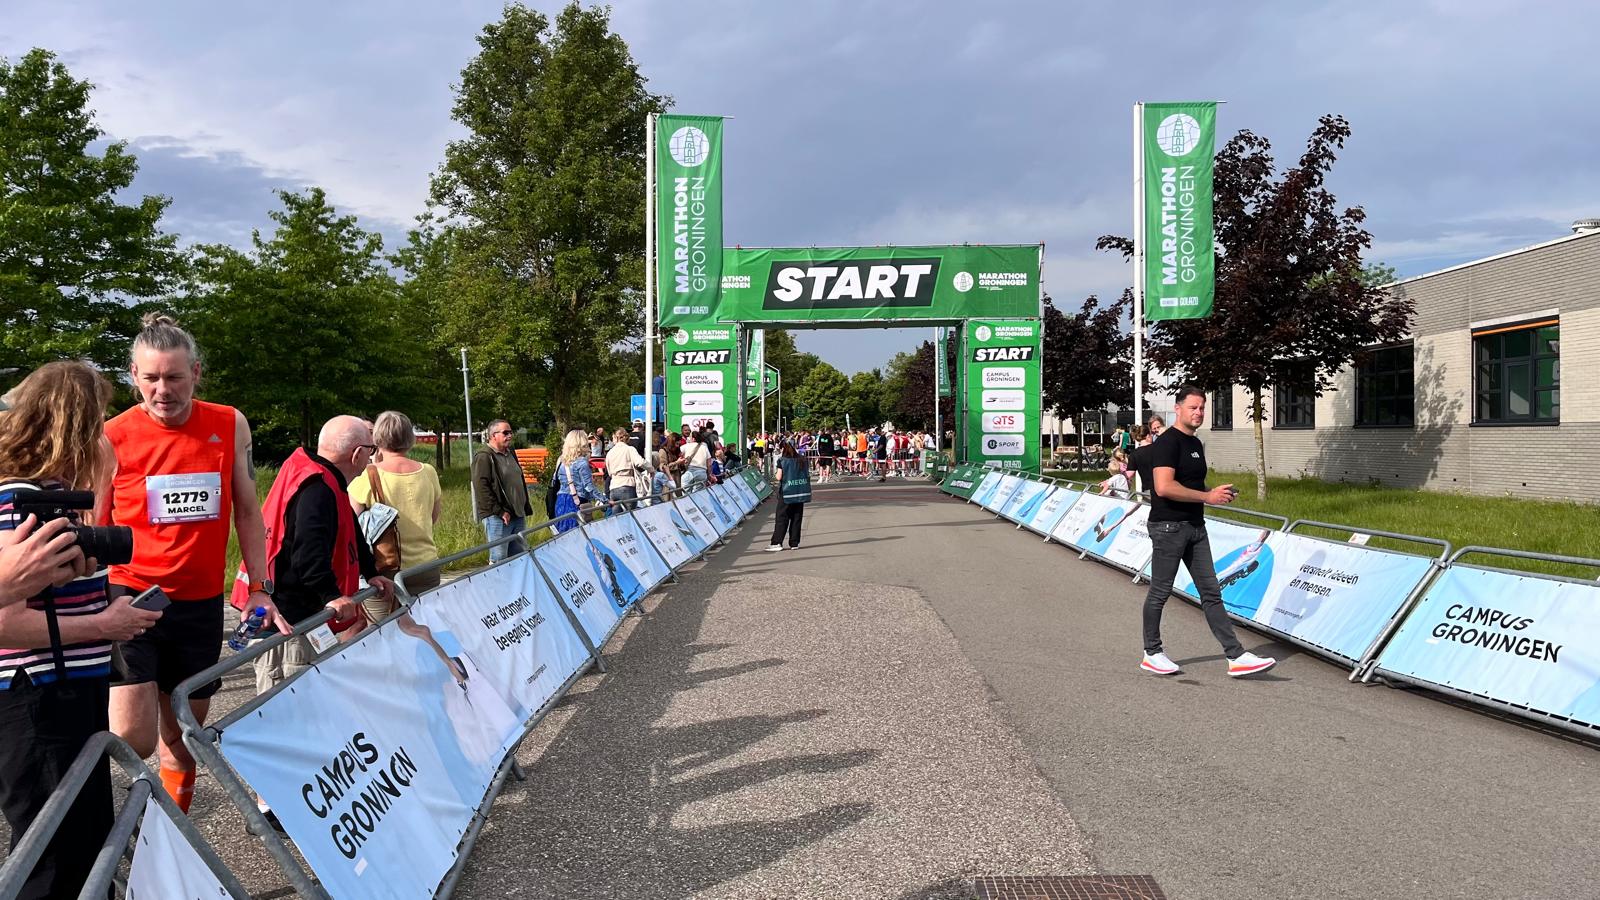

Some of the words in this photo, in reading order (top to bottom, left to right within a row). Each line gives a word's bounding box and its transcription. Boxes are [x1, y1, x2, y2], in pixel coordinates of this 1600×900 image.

[674, 177, 689, 293] MARATHON
[691, 176, 707, 292] GRONINGEN
[1161, 167, 1177, 285] MARATHON
[1180, 165, 1196, 283] GRONINGEN
[773, 265, 932, 302] START
[673, 350, 729, 365] START
[975, 347, 1032, 361] START
[692, 418, 714, 428] QT
[992, 416, 1015, 425] QTS
[162, 490, 209, 505] 12779
[167, 505, 206, 514] MARCEL
[1445, 604, 1534, 631] CAMPUS
[1432, 622, 1563, 663] GRONINGEN
[301, 732, 379, 819] CAMPUS
